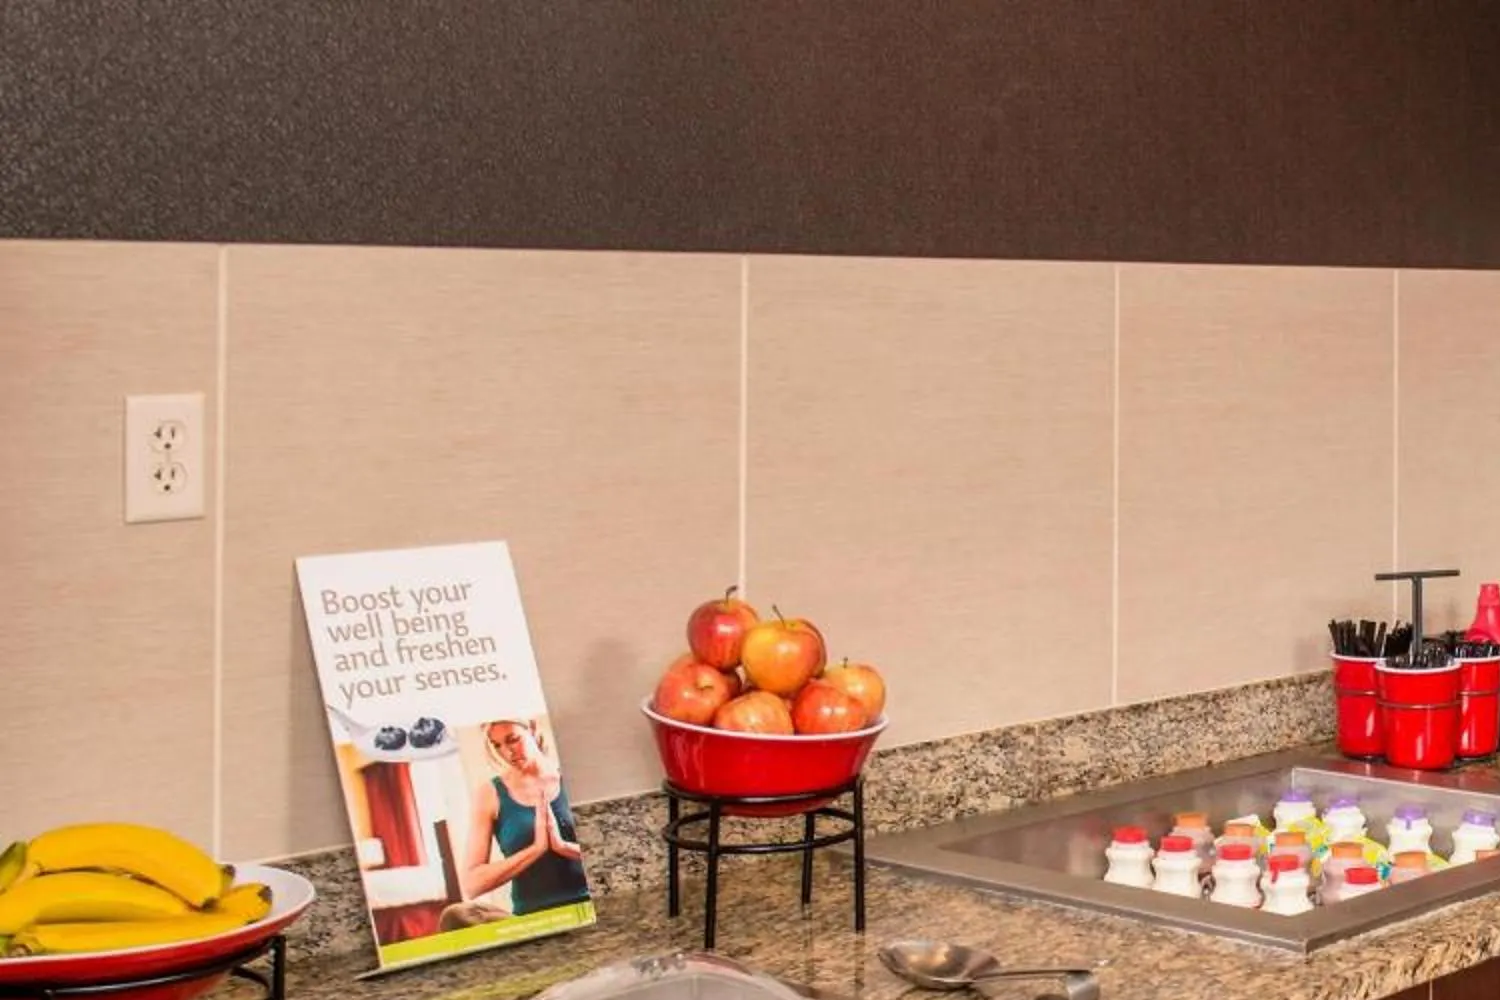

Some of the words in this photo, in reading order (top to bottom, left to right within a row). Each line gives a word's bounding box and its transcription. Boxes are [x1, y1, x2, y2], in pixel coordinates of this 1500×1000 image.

[320, 585, 402, 615] Boost
[409, 582, 473, 613] your
[327, 612, 383, 643] well
[391, 608, 469, 637] being
[334, 641, 389, 672] and
[396, 632, 497, 664] freshen
[339, 674, 405, 710] your
[415, 662, 508, 691] senses.
